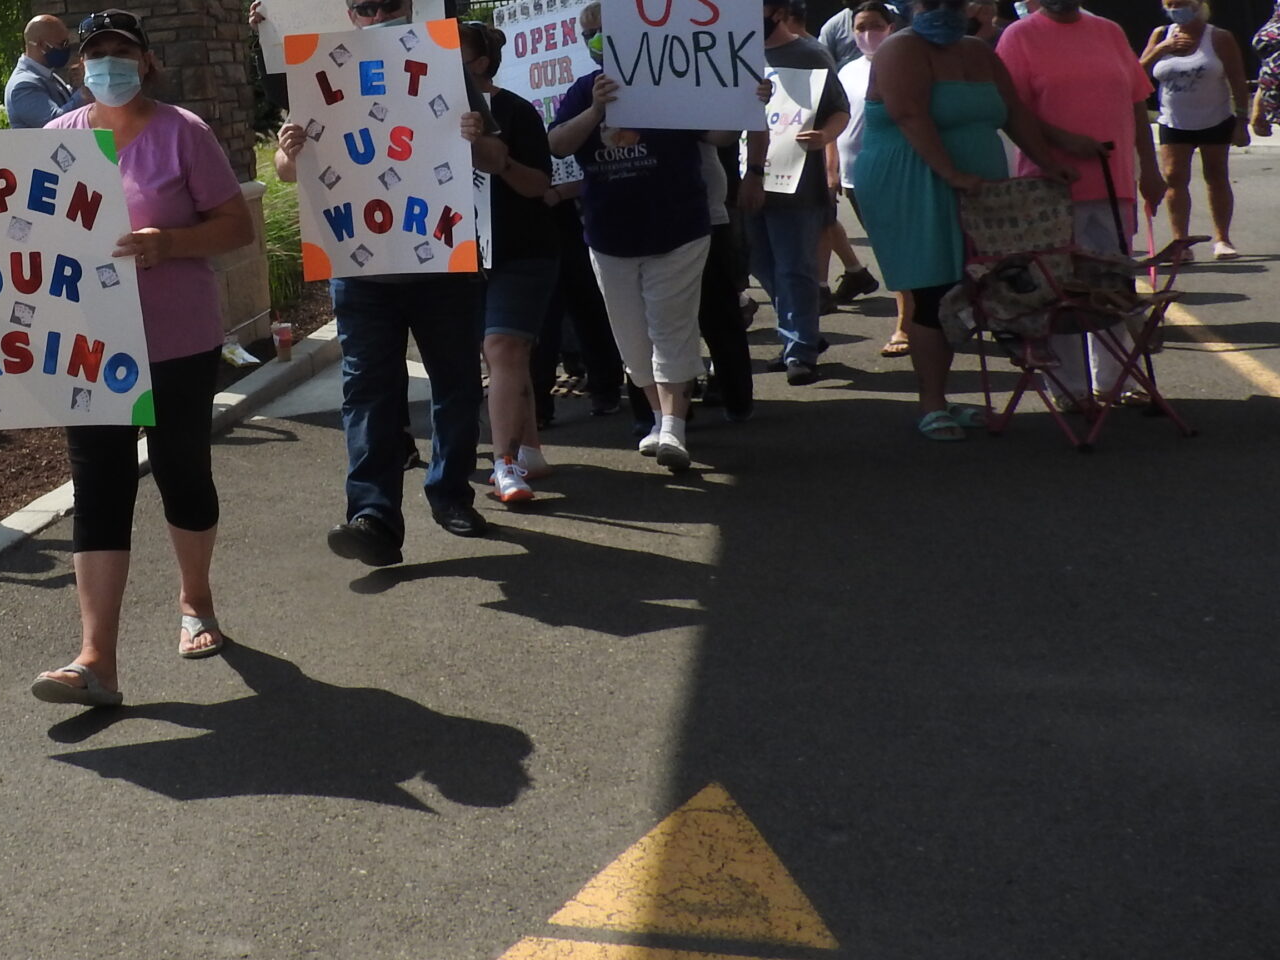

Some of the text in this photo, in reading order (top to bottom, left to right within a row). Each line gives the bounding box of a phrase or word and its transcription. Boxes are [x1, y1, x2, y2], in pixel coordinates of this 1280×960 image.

[513, 17, 578, 59] OPEN
[606, 30, 763, 88] WORK
[315, 58, 428, 106] LET
[529, 56, 574, 90] OUR
[343, 125, 414, 166] US
[595, 143, 648, 162] CORGIS
[322, 195, 463, 248] WORK
